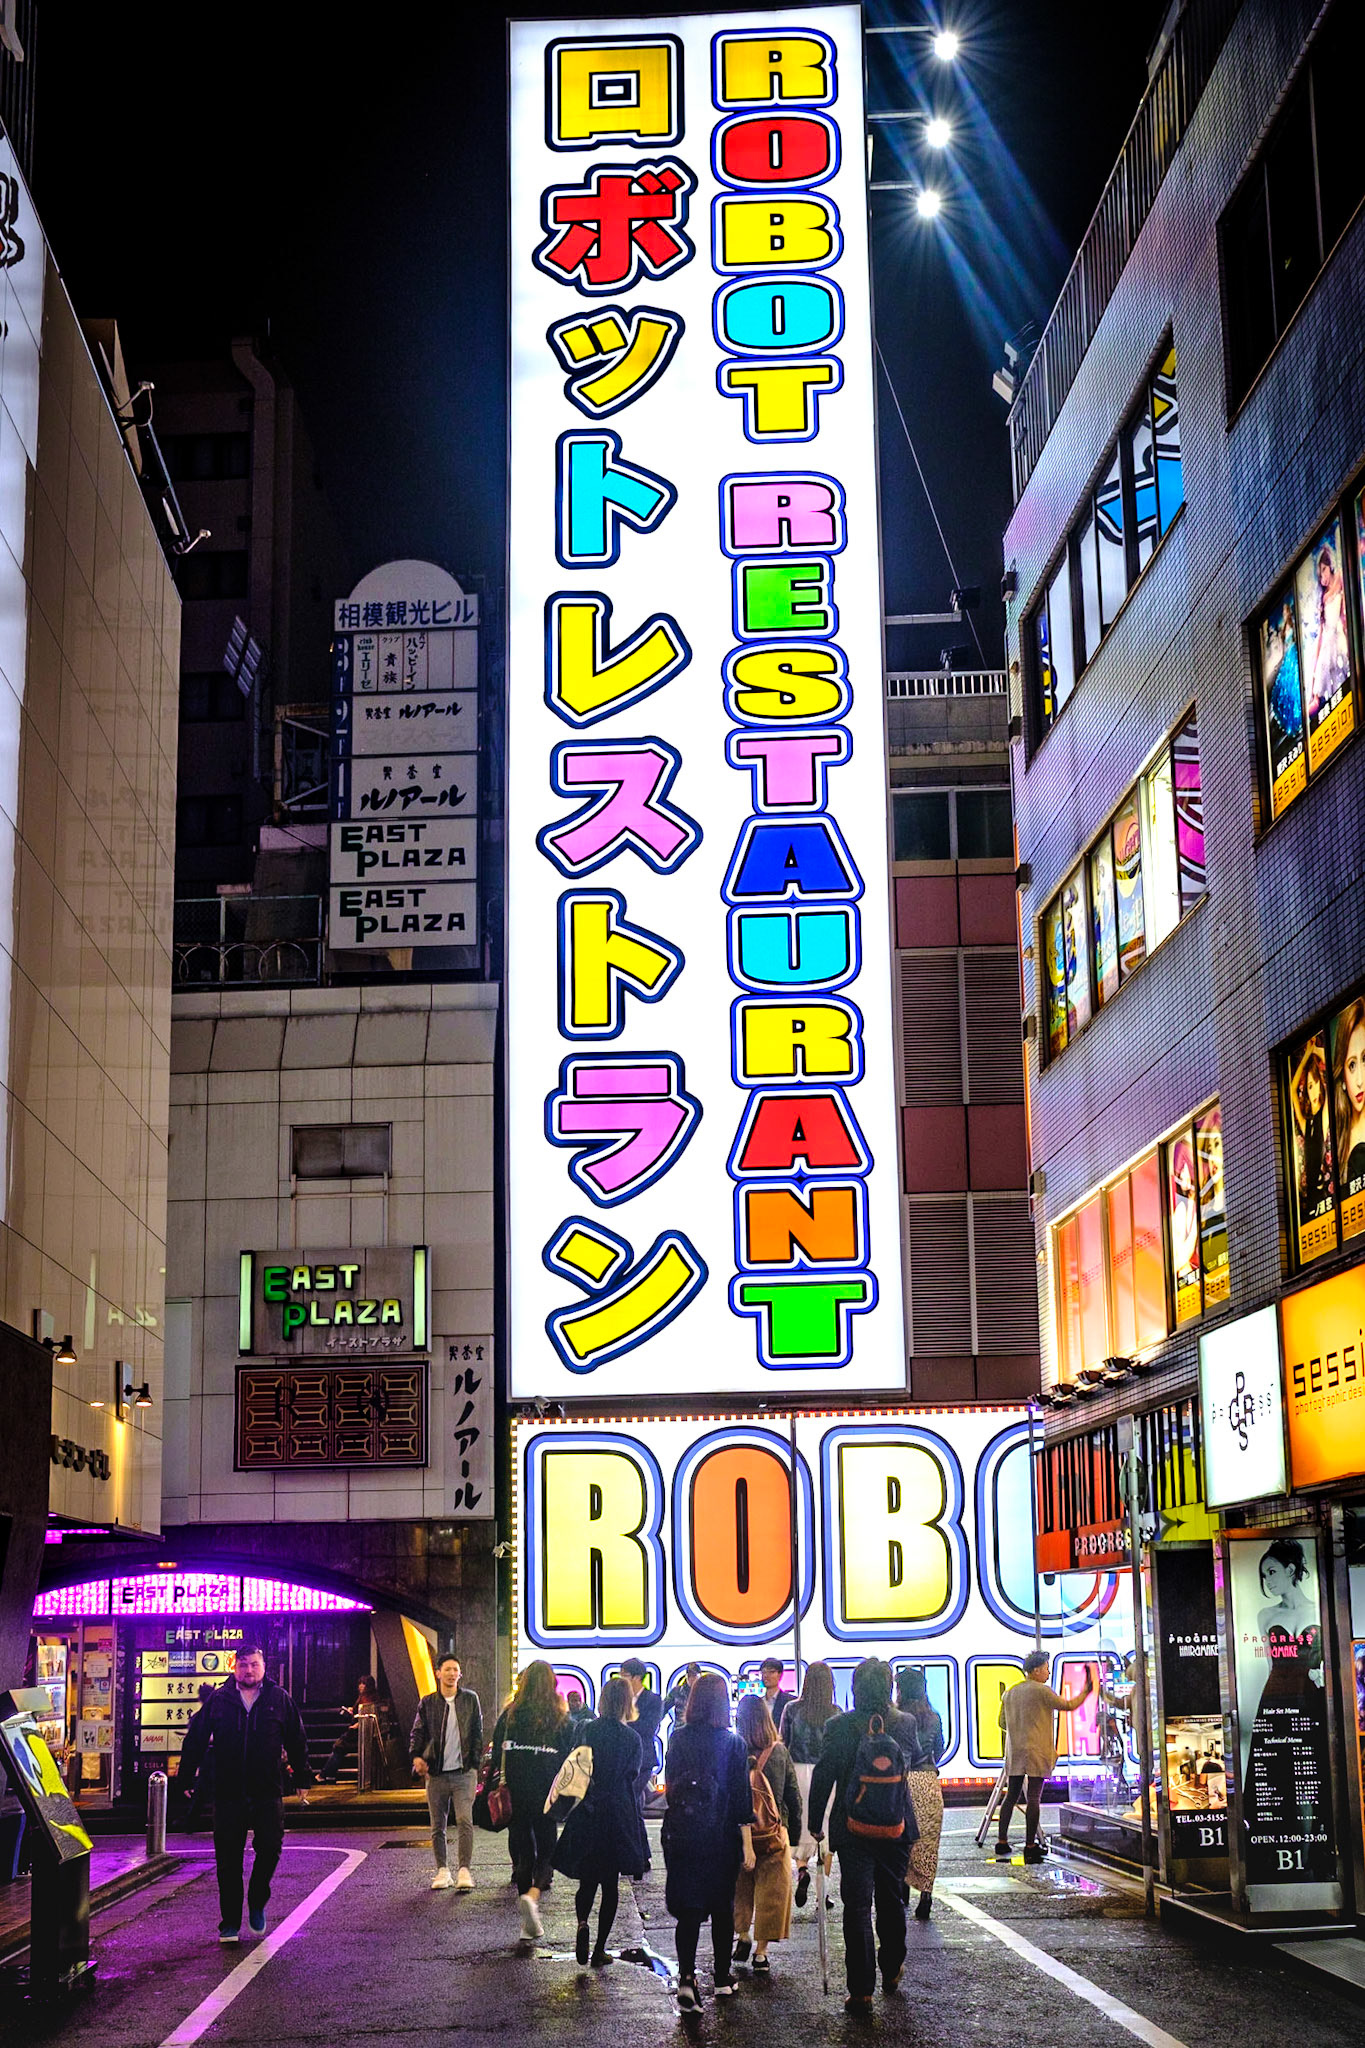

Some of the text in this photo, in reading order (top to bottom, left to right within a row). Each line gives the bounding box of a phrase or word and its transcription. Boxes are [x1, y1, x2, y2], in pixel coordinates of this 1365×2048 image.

[339, 599, 474, 628] 相模観光ビル
[361, 652, 373, 690] エリーゼ
[399, 702, 462, 719] ルノアール
[532, 33, 708, 1373] ロボットレストラン
[711, 27, 878, 1370] ROBOT RESTAURANT
[360, 785, 467, 811] ルノアール
[340, 824, 427, 852] EAST
[356, 848, 466, 877] PLAZA
[339, 889, 427, 917] EAST
[355, 913, 466, 943] PLAZA
[263, 1264, 360, 1301] EAST
[282, 1298, 402, 1340] PLAZA
[453, 1367, 483, 1511] ルノアール
[1074, 1527, 1133, 1557] PROGRES
[122, 1585, 229, 1603] EAST PLAZA
[166, 1629, 243, 1644] EAST PLAZA
[1199, 1827, 1225, 1847] B1
[1276, 1850, 1305, 1871] B1
